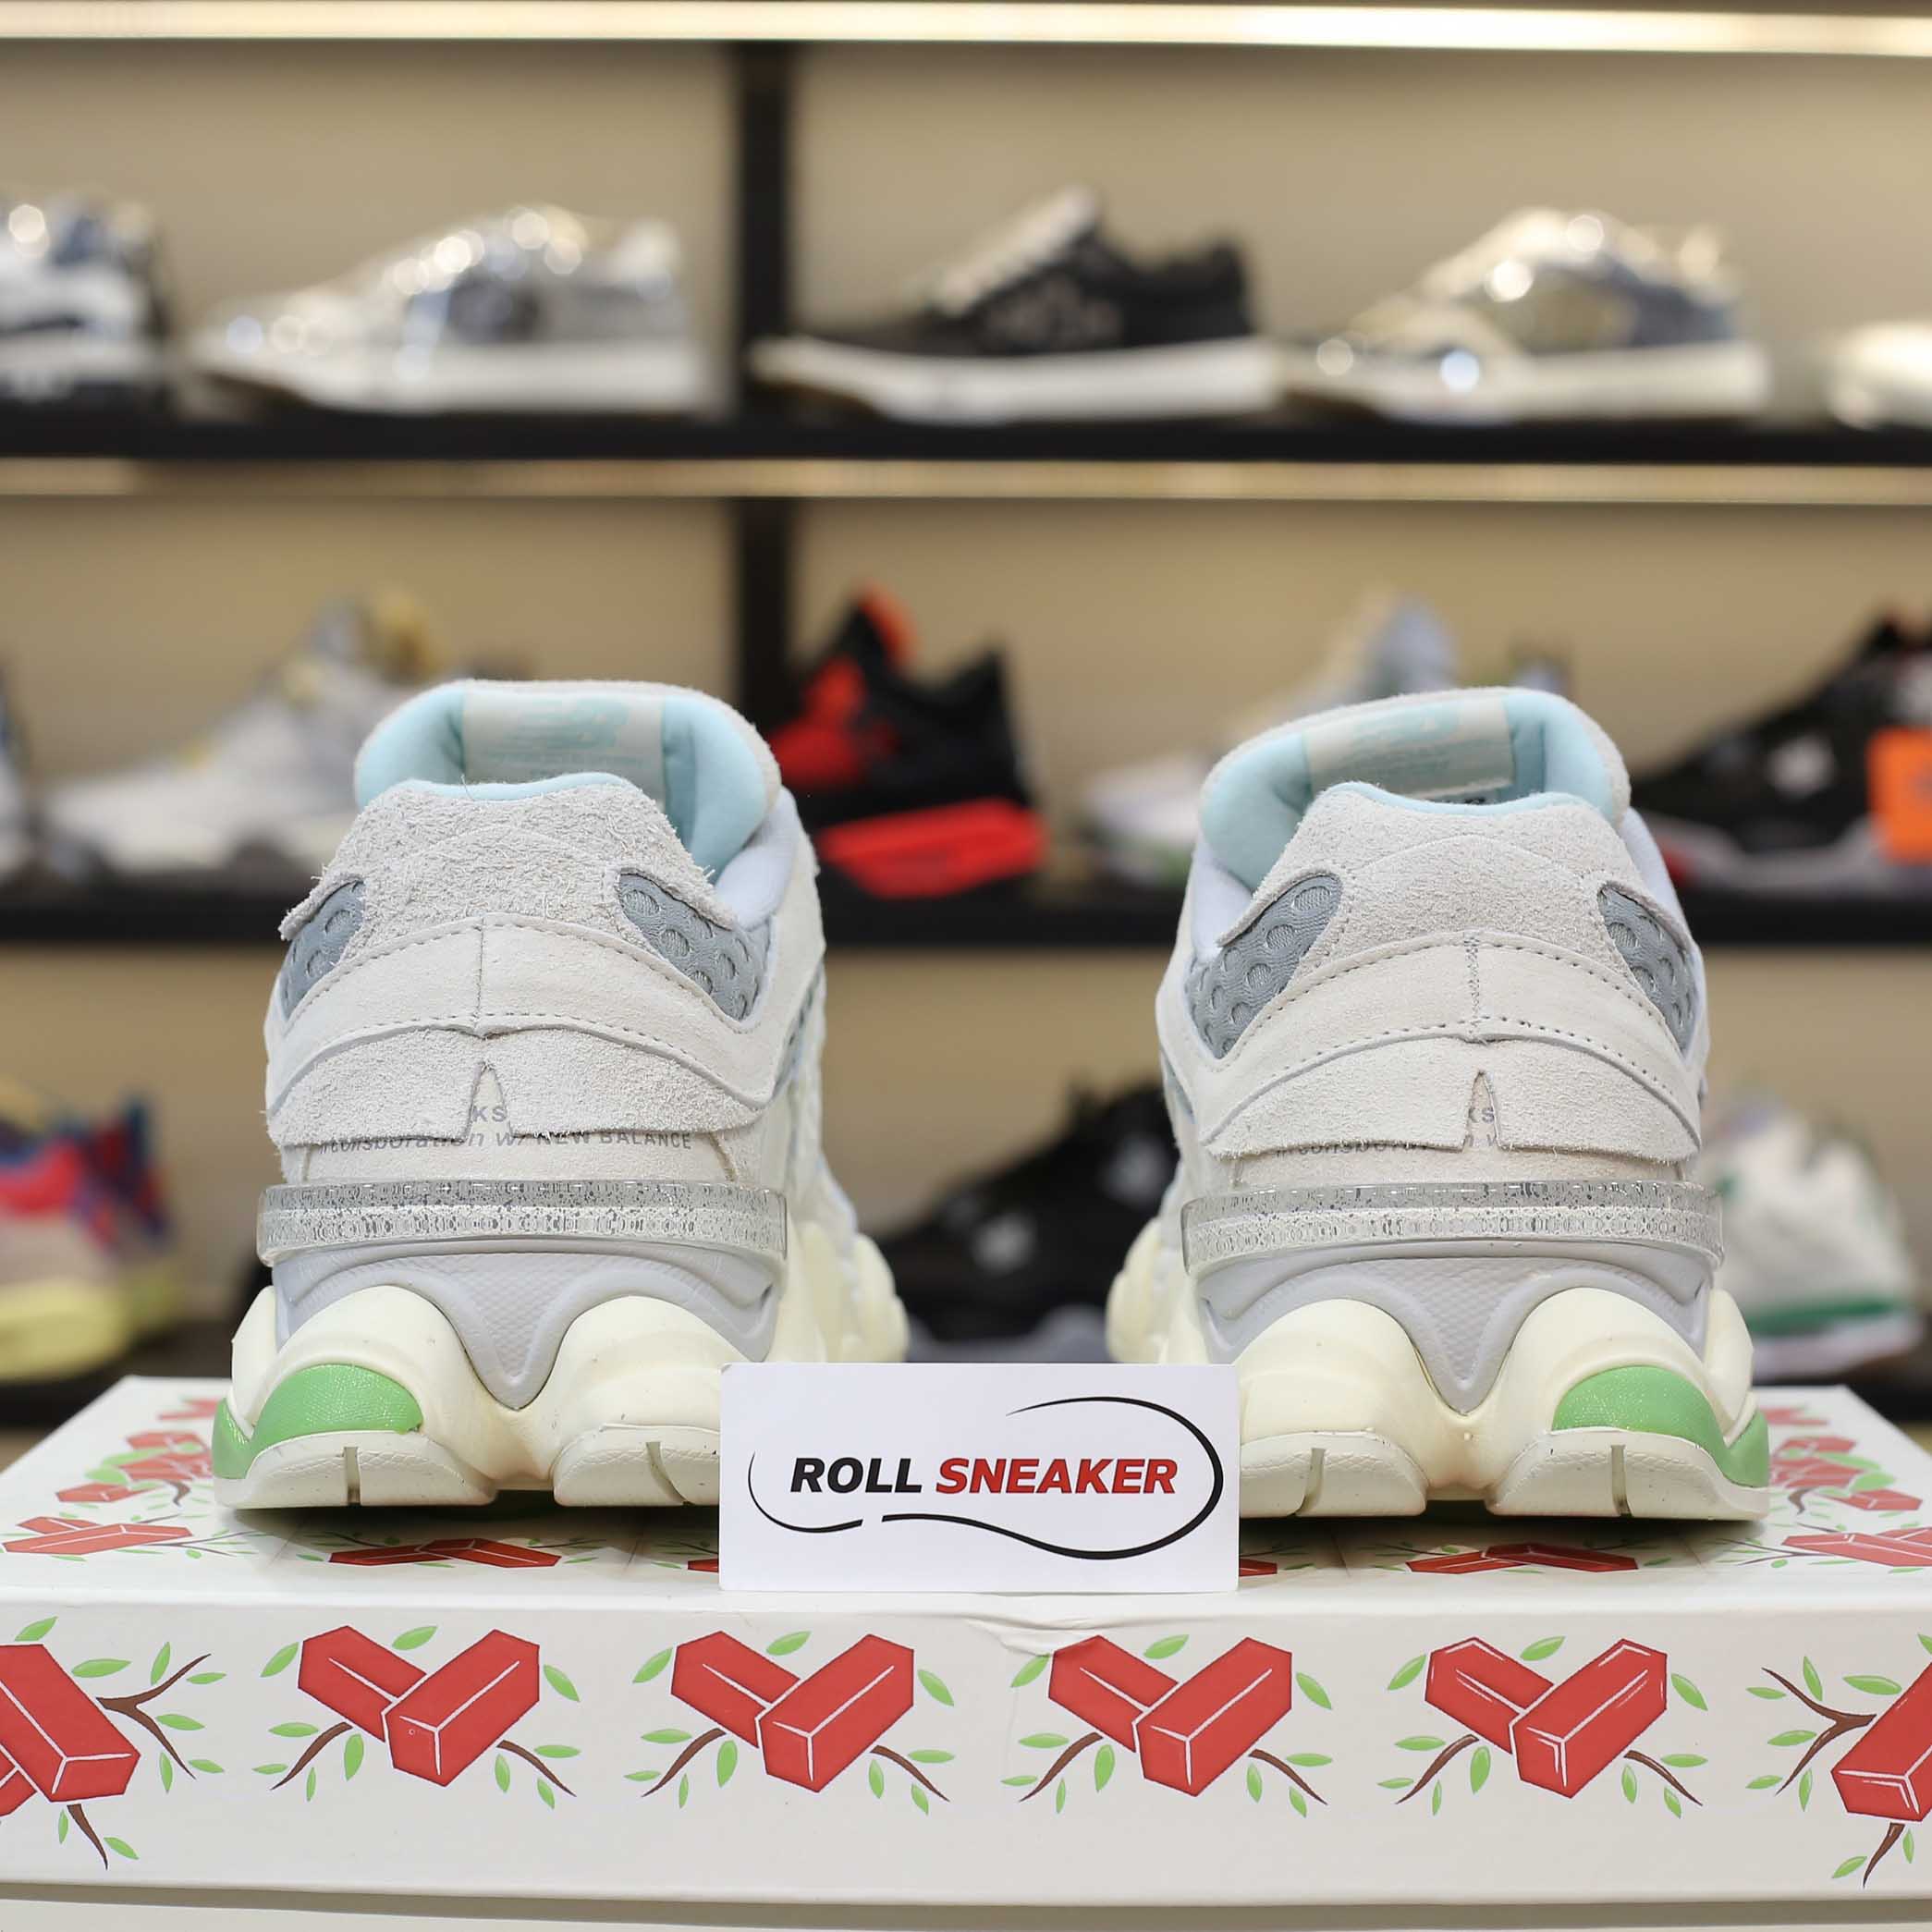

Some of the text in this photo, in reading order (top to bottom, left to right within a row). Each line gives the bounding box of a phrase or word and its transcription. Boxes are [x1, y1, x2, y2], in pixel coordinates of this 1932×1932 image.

[599, 1131, 691, 1150] BALANCE
[789, 1457, 1178, 1495] ROLL SNEAKER
